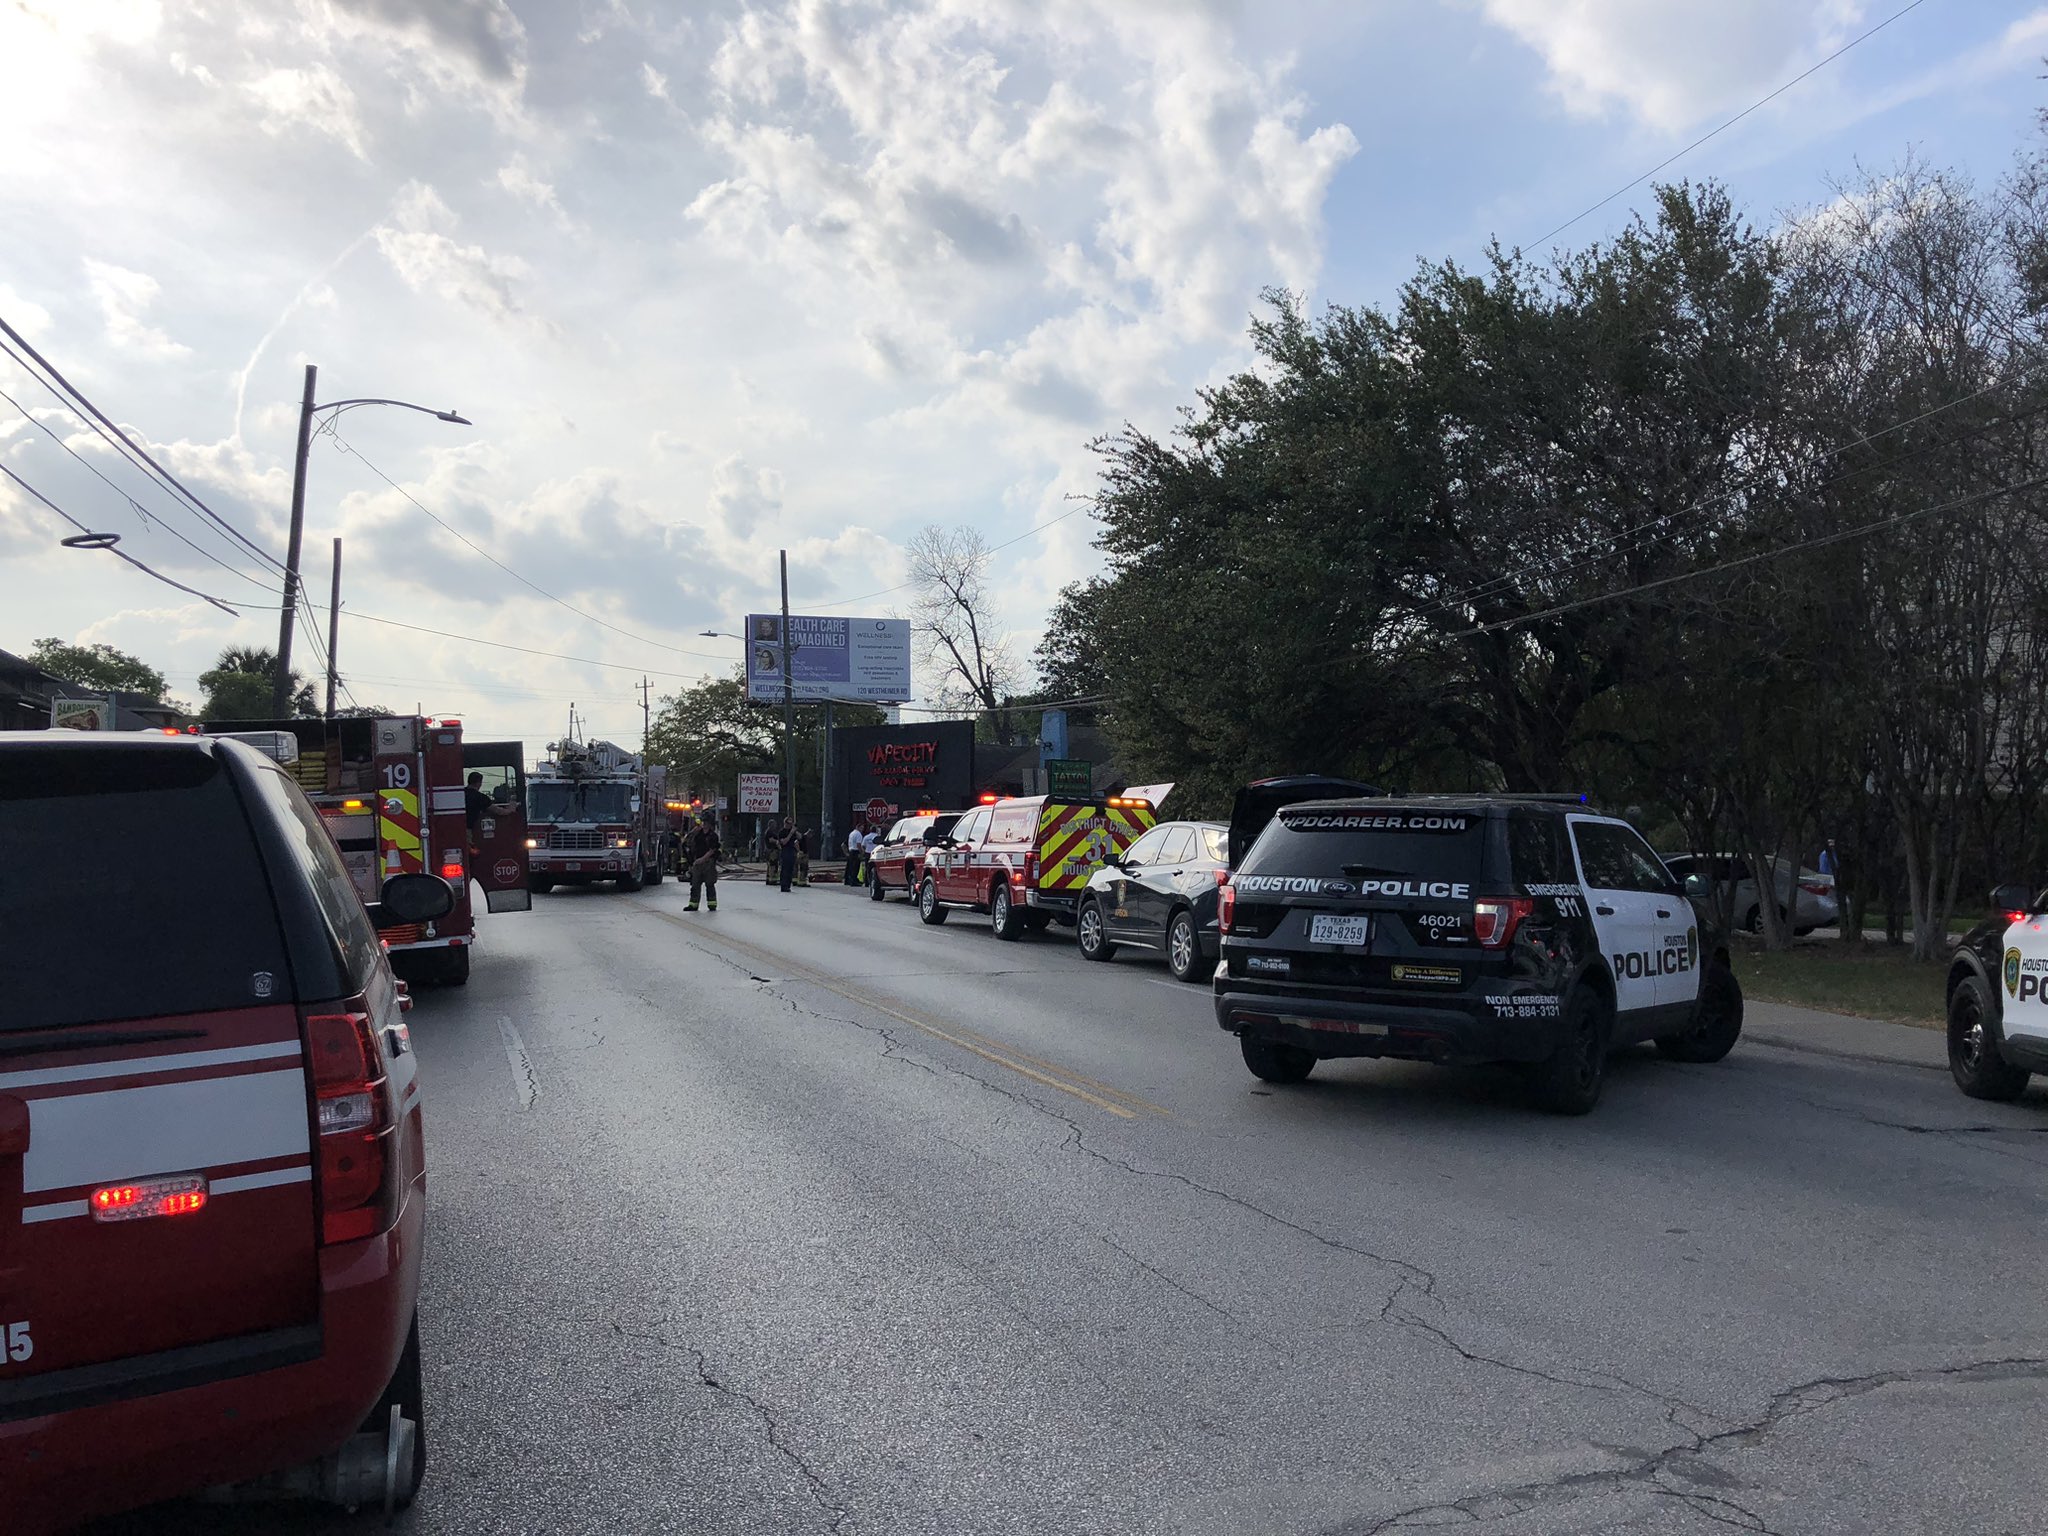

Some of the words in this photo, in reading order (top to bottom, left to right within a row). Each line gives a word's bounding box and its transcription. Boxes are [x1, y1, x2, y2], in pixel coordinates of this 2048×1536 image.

[820, 620, 846, 632] CARE
[857, 687, 867, 695] 120
[867, 741, 938, 764] VAPECITY
[383, 763, 411, 788] 19
[741, 775, 779, 784] VAPECITY
[745, 799, 773, 807] OPEN
[867, 806, 887, 818] STOP
[1060, 817, 1107, 836] DISTRICT
[1109, 819, 1140, 839] CHIEF
[1281, 816, 1466, 830] HPDCAREER.COM
[1085, 832, 1114, 862] 31
[495, 866, 518, 876] STOP
[1239, 876, 1321, 893] HOUSTON
[1361, 880, 1470, 900] POLICE
[1524, 883, 1584, 896] EMERGENCY
[1554, 897, 1582, 918] 911
[1418, 914, 1461, 927] 46021
[1430, 928, 1439, 940] C
[1664, 934, 1687, 946] HOUSTON
[1613, 947, 1689, 981] POLICE
[1485, 995, 1510, 1005] NON
[1512, 995, 1559, 1004] EMERGENCY
[1494, 1005, 1560, 1018] 713-884-3131
